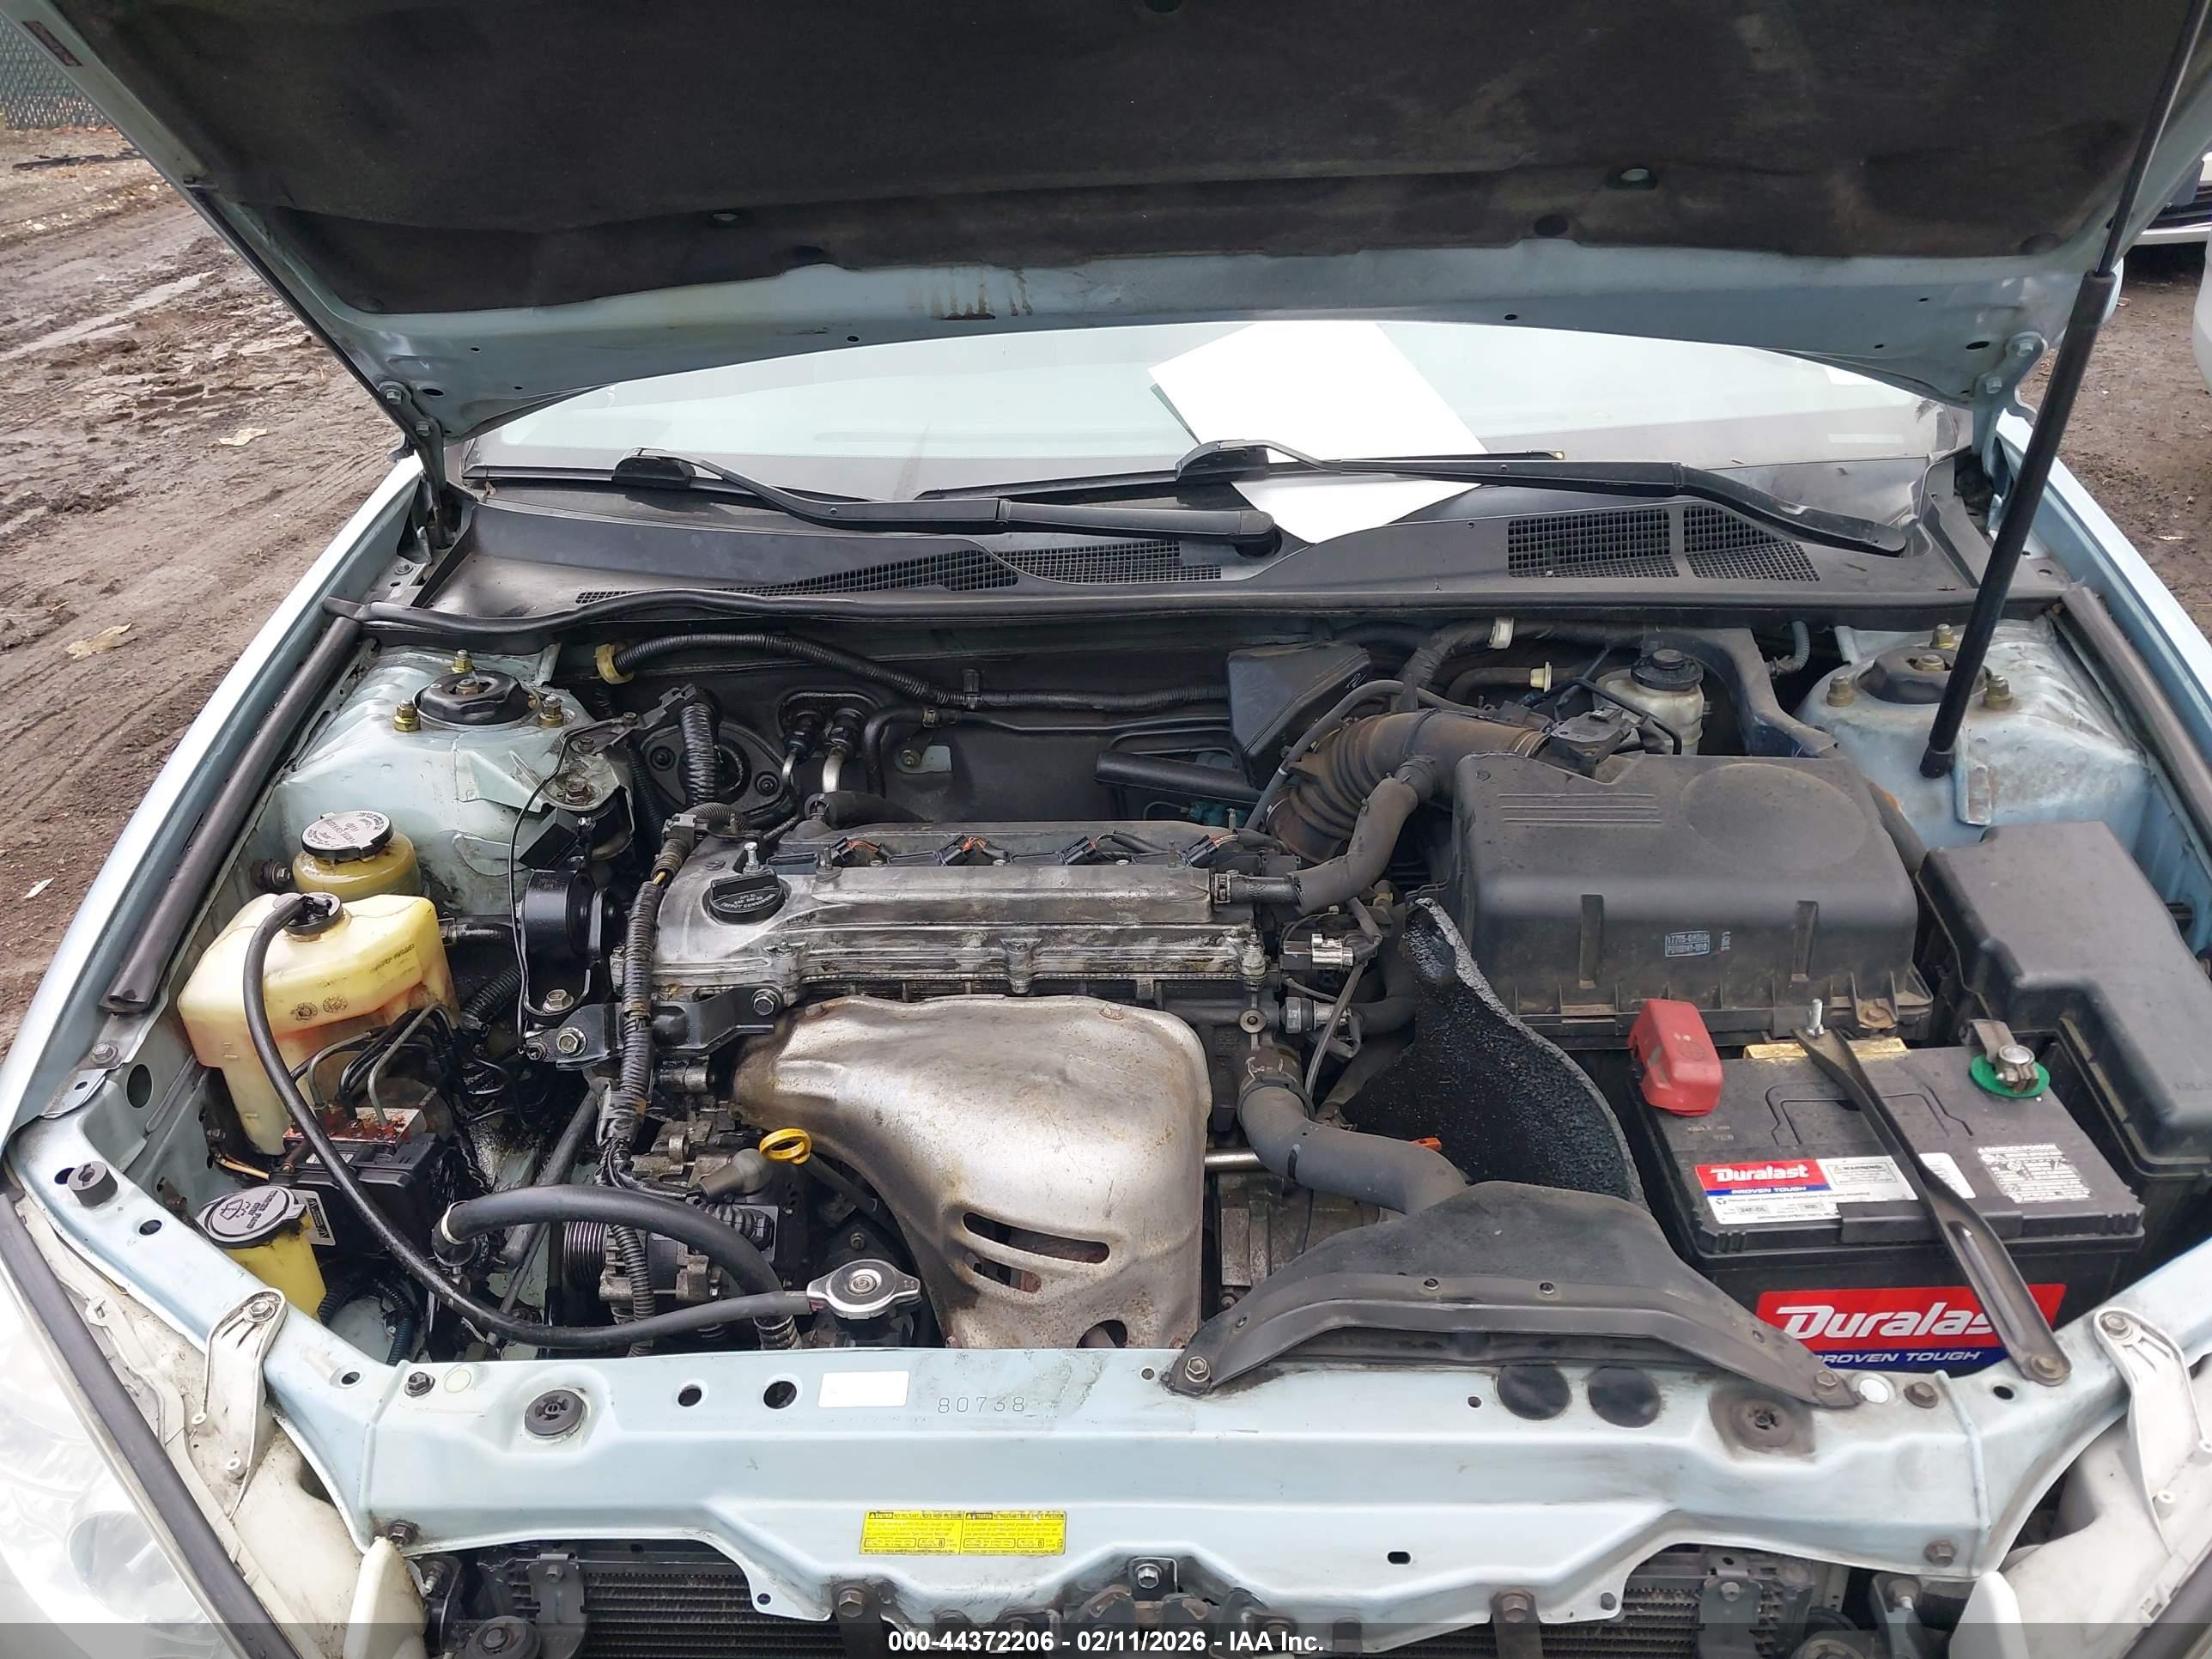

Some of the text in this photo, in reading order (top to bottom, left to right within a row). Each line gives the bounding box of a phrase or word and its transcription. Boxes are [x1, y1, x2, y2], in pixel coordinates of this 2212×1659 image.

[1710, 1164, 1809, 1182] Duralast
[1777, 1302, 1993, 1340] Duralas
[1905, 1351, 1981, 1362] TOUGH
